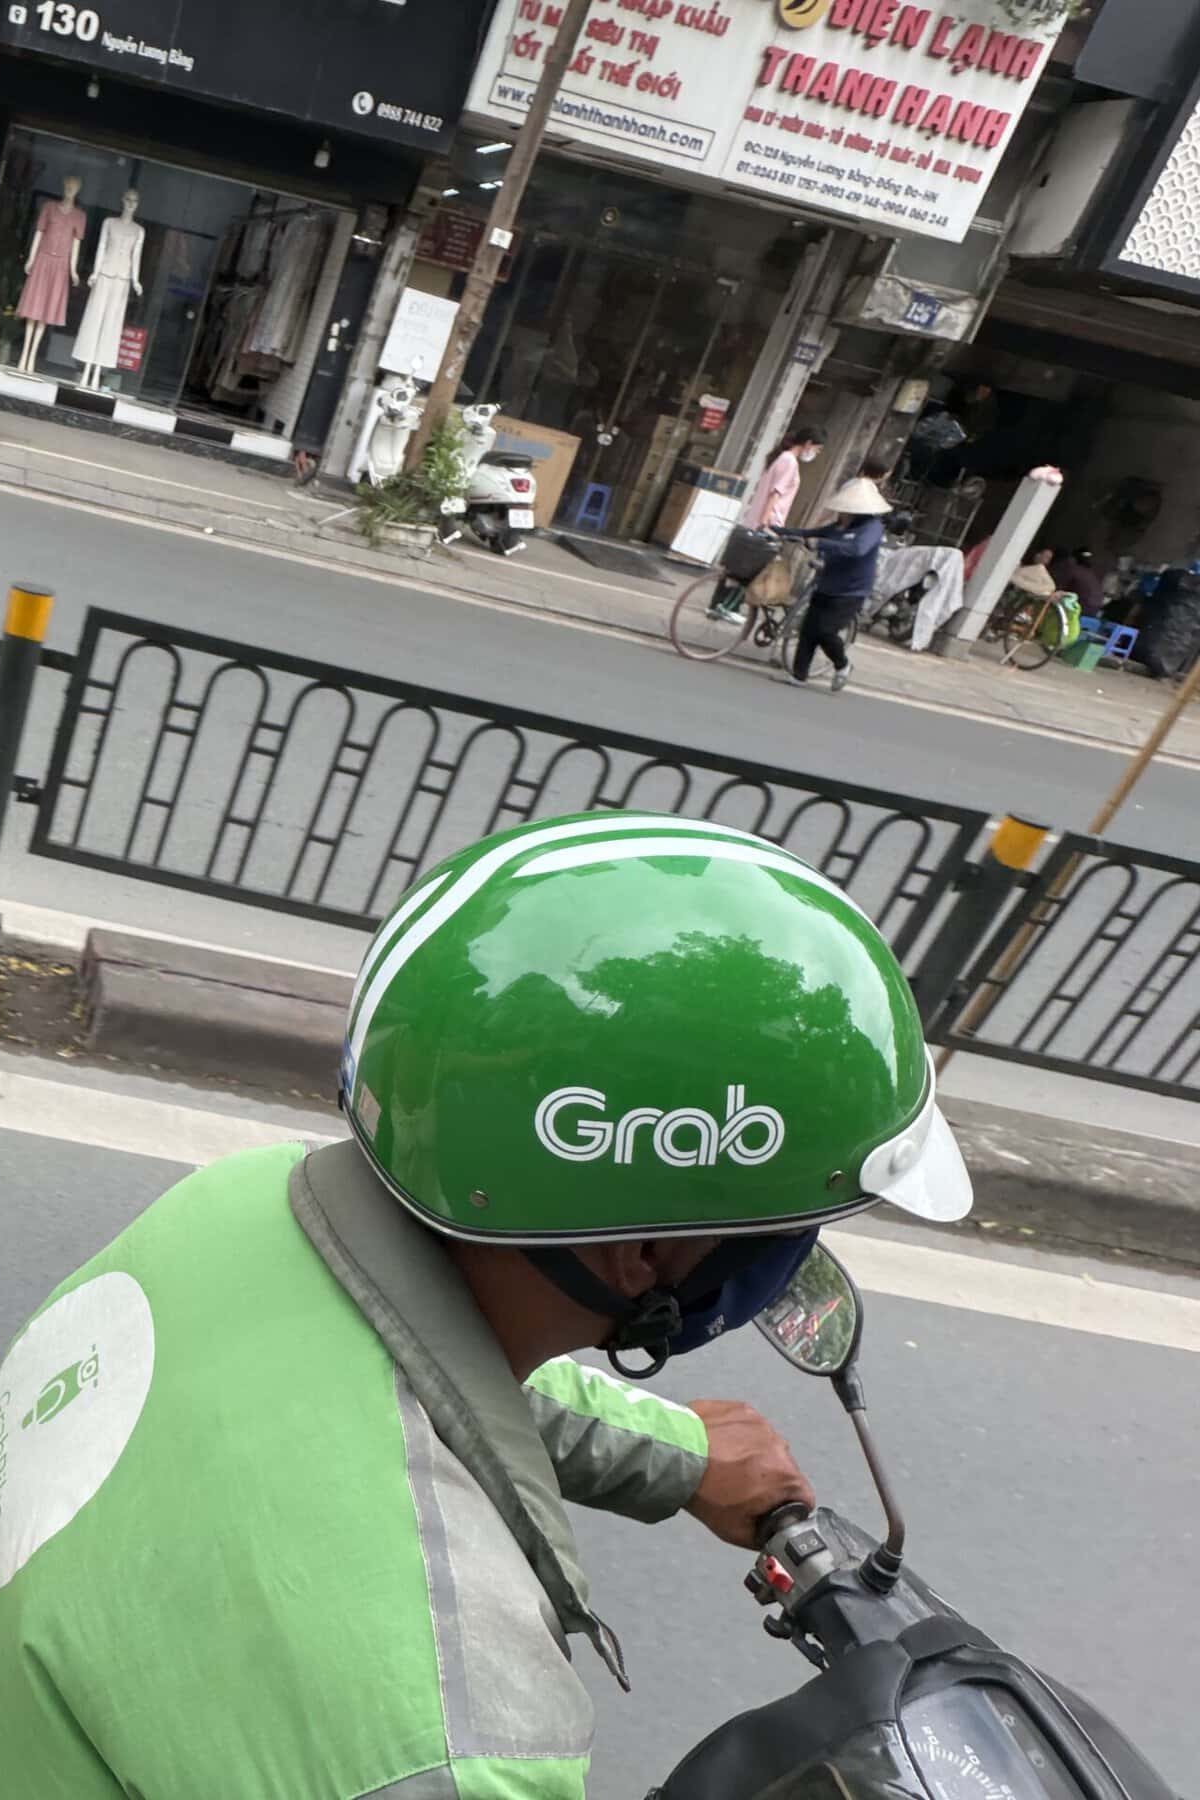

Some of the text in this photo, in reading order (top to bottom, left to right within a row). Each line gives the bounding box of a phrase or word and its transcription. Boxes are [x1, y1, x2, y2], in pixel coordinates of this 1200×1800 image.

[36, 1, 100, 42] 130
[101, 31, 138, 54] Nguyễn
[137, 41, 168, 64] Lương
[584, 16, 625, 46] SIÊU
[627, 29, 660, 61] THỊ
[673, 2, 732, 37] KHẨU
[929, 16, 1044, 80] LẠNH
[599, 60, 640, 88] THẾ
[635, 71, 683, 100] GIỚI
[757, 46, 1012, 149] THANH HẠNH
[535, 1084, 785, 1167] Grab
